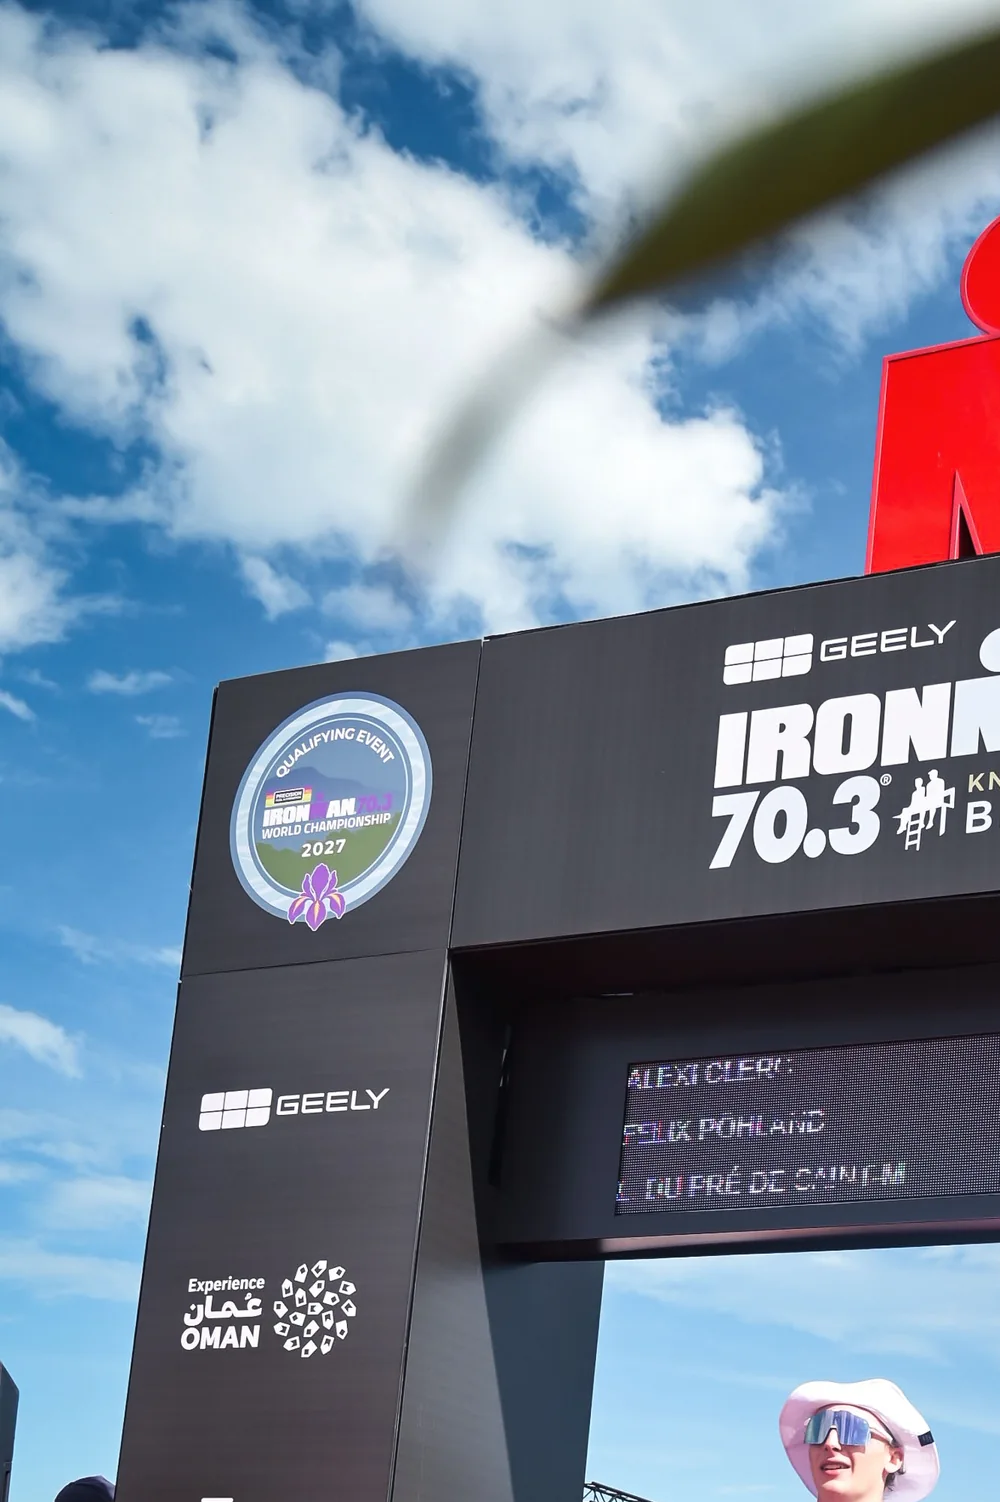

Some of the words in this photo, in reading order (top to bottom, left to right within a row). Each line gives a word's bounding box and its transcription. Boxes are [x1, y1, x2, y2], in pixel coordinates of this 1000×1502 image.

[820, 620, 957, 662] GEELY
[276, 728, 355, 778] QUALIFYING
[356, 729, 395, 763] EVENT
[263, 792, 356, 827] IRONMAN
[709, 775, 881, 870] 70.3
[262, 825, 302, 839] WORLD
[304, 812, 391, 834] CHAMPIONSHIP
[302, 839, 346, 857] 2027
[276, 1088, 390, 1116] GEELY
[688, 1166, 741, 1196] PRÉ
[188, 1276, 265, 1294] Experience
[181, 1325, 260, 1350] OMAN
